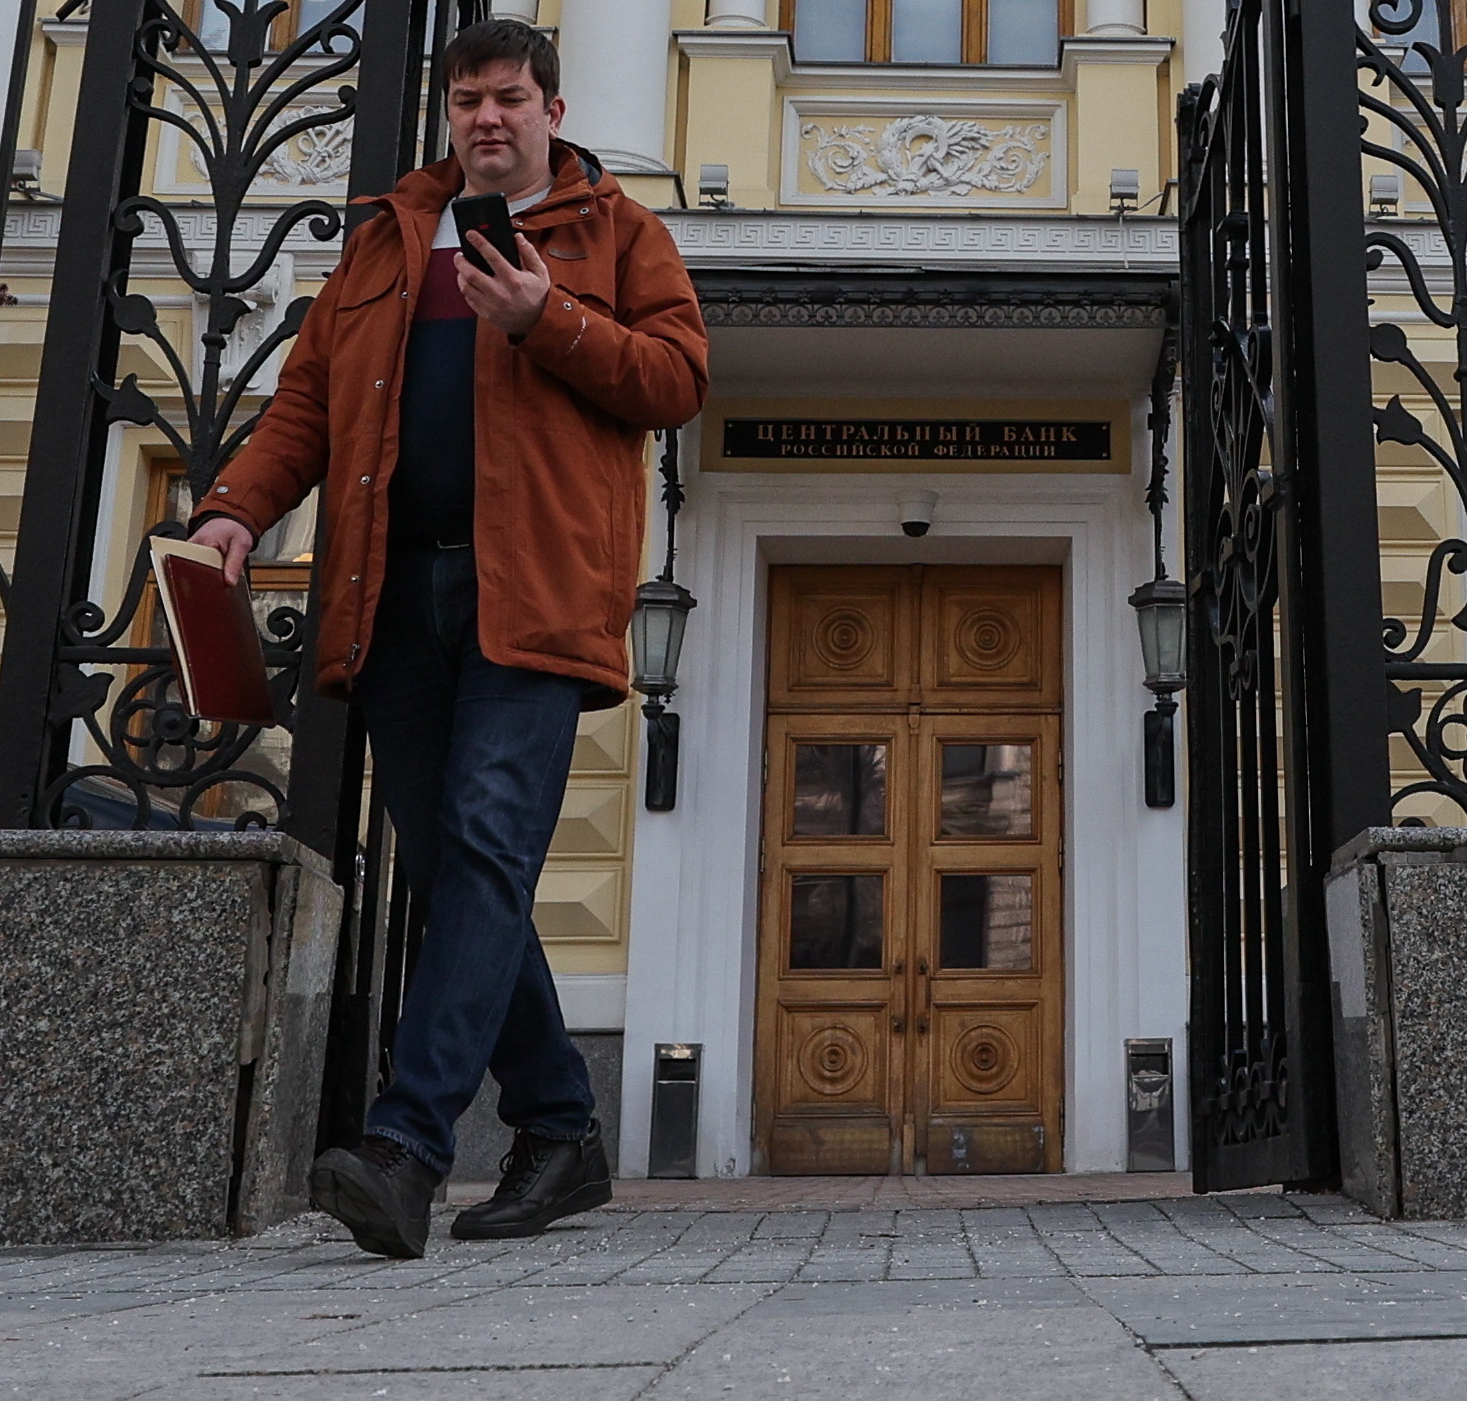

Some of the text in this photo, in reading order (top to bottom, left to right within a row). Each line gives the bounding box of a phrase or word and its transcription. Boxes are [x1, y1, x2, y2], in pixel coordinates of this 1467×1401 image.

[757, 423, 1078, 442] ЦЕНТРАЛЬНЫЙ БАНК
[781, 442, 1055, 458] РОССИЙСКОЙ ФЕДЕРАЦИИ
